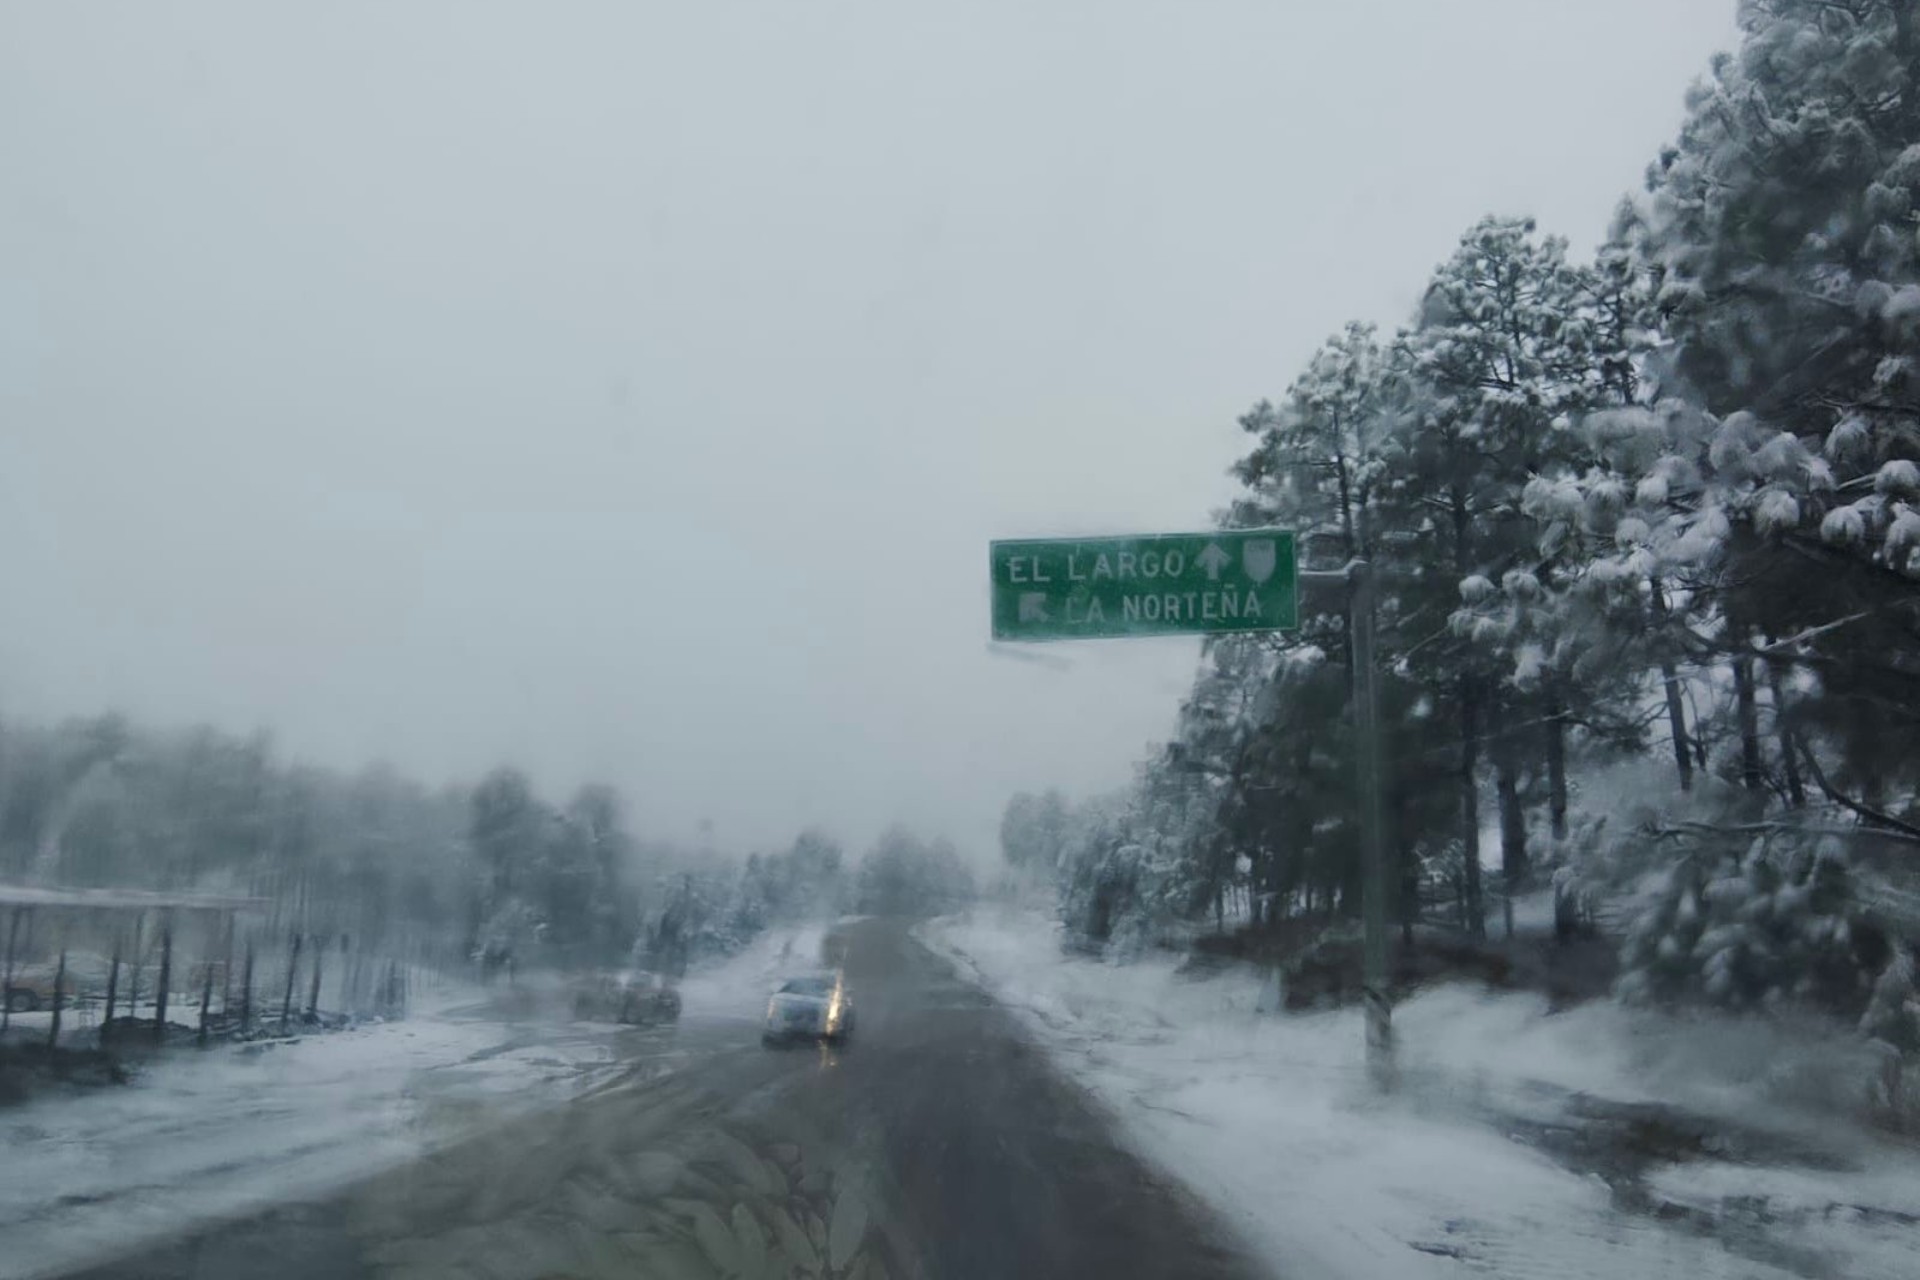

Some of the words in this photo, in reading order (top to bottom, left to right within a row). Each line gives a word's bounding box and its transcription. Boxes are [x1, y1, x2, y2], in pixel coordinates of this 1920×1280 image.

[1008, 555, 1049, 582] EL
[1067, 552, 1185, 580] LARGO
[1065, 594, 1105, 623] LA
[1123, 584, 1262, 621] NORTEÑA
